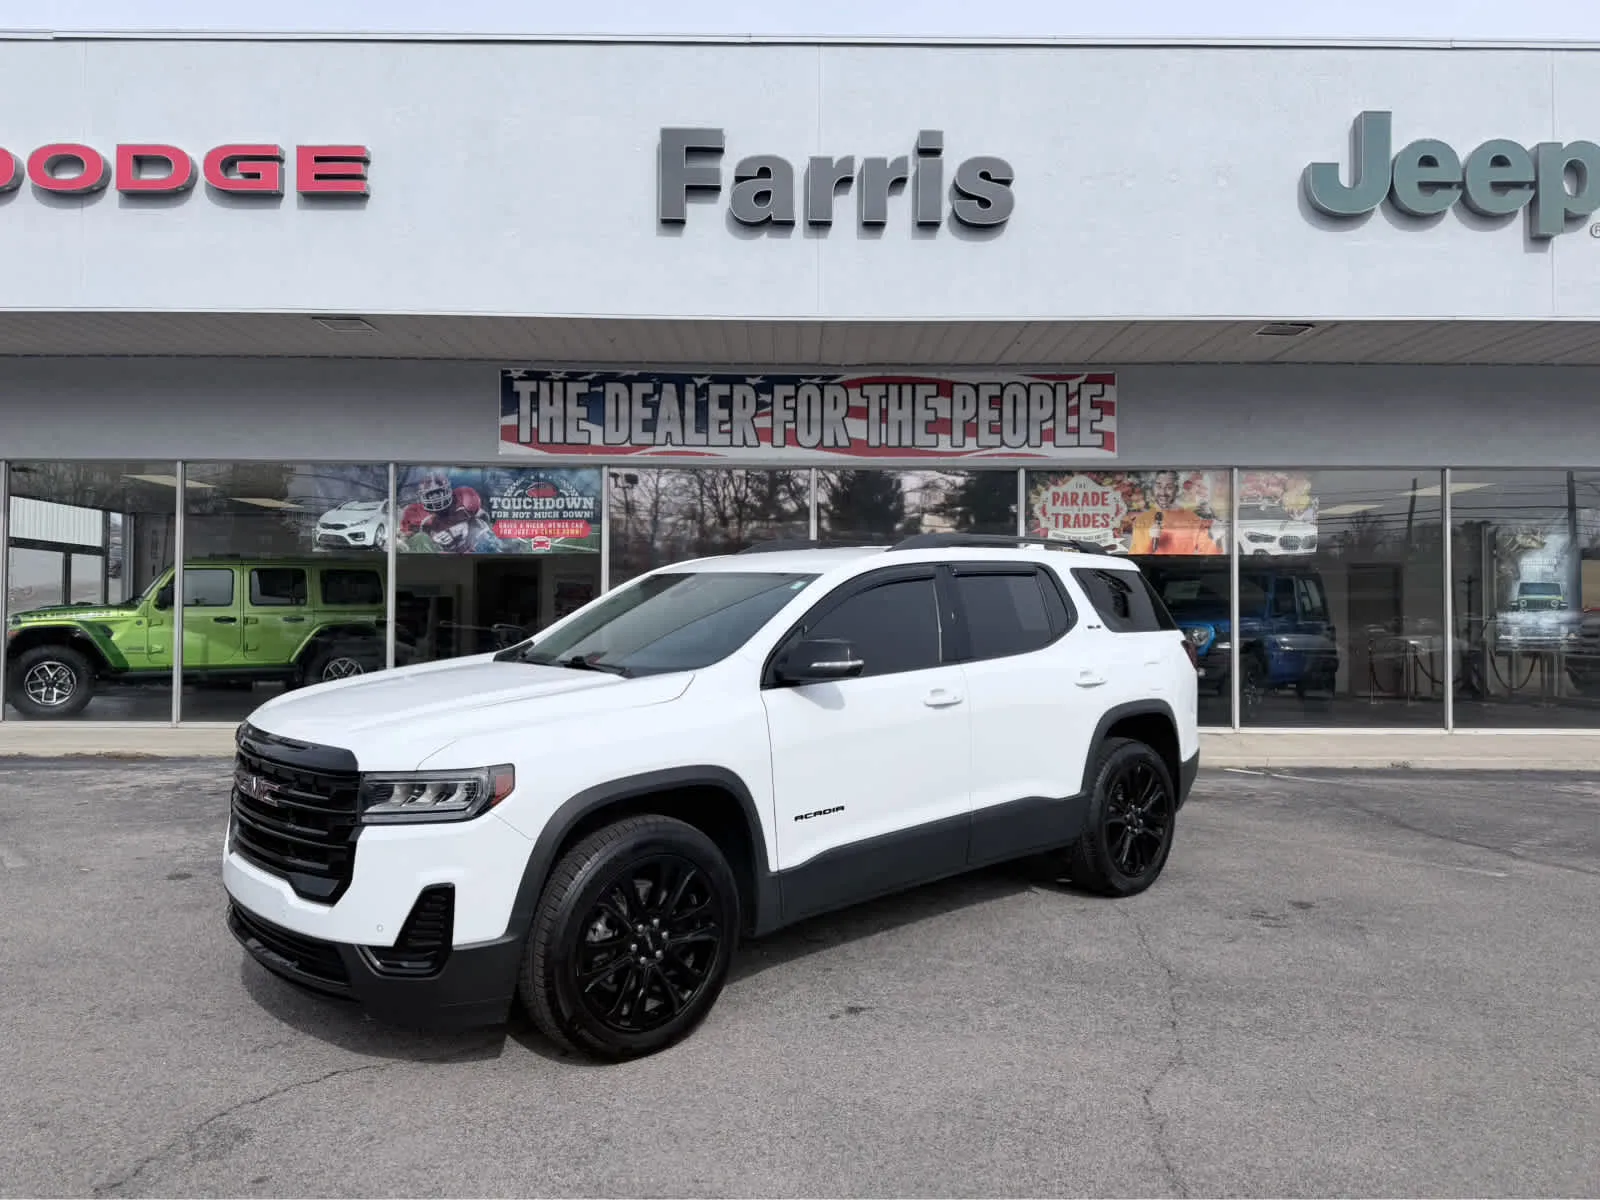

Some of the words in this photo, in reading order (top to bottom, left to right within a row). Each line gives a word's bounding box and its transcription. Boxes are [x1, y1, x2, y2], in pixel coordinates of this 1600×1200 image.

[0, 143, 369, 196] ODGE
[659, 128, 1015, 226] Farris
[1303, 111, 1600, 238] Jeep
[512, 380, 592, 445] THE
[602, 381, 761, 448] DEALER
[771, 382, 850, 448] FOR
[861, 382, 940, 448] THE
[950, 382, 1105, 448] PEOPLE
[489, 497, 594, 509] TOUCHDOWN
[1051, 491, 1110, 507] PARADE
[491, 511, 509, 519] FOR
[512, 511, 531, 519] NOT
[534, 511, 560, 519] MUCH
[562, 511, 594, 519] DOWN!
[1051, 512, 1110, 529] TRADES
[794, 805, 845, 822] ACADIA
